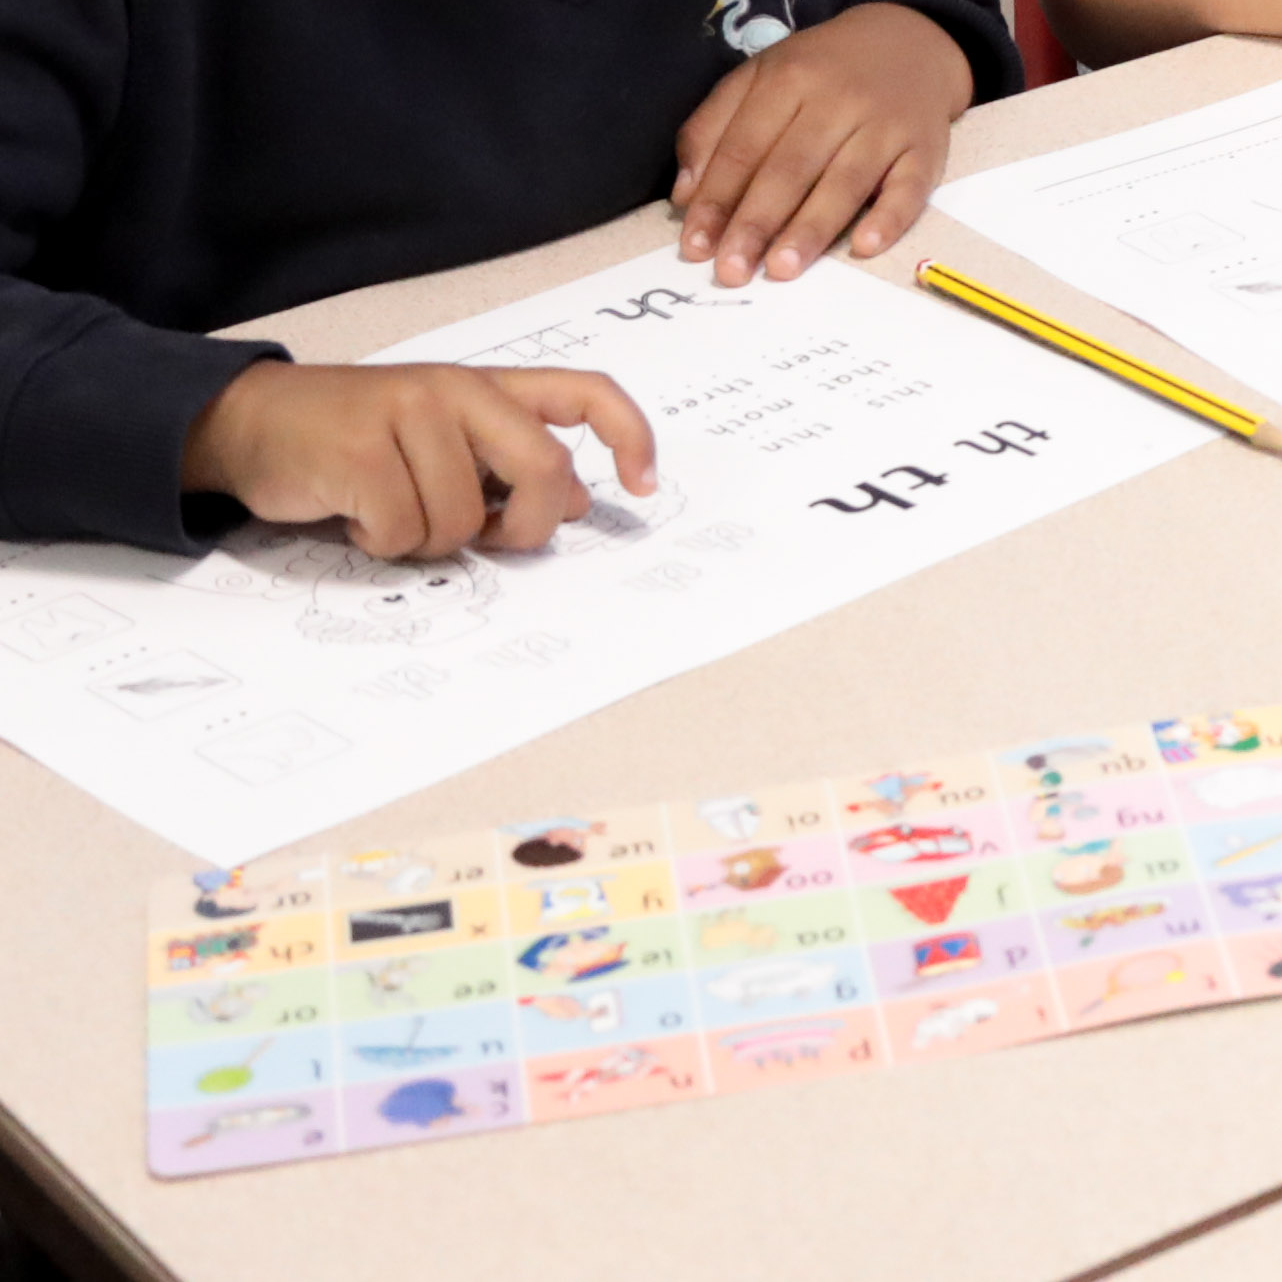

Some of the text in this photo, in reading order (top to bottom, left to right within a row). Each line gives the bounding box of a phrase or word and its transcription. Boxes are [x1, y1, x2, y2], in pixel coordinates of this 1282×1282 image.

[660, 338, 851, 419] then three
[703, 357, 892, 439] that moth
[758, 378, 933, 456] this thin
[807, 420, 1053, 515] th th
